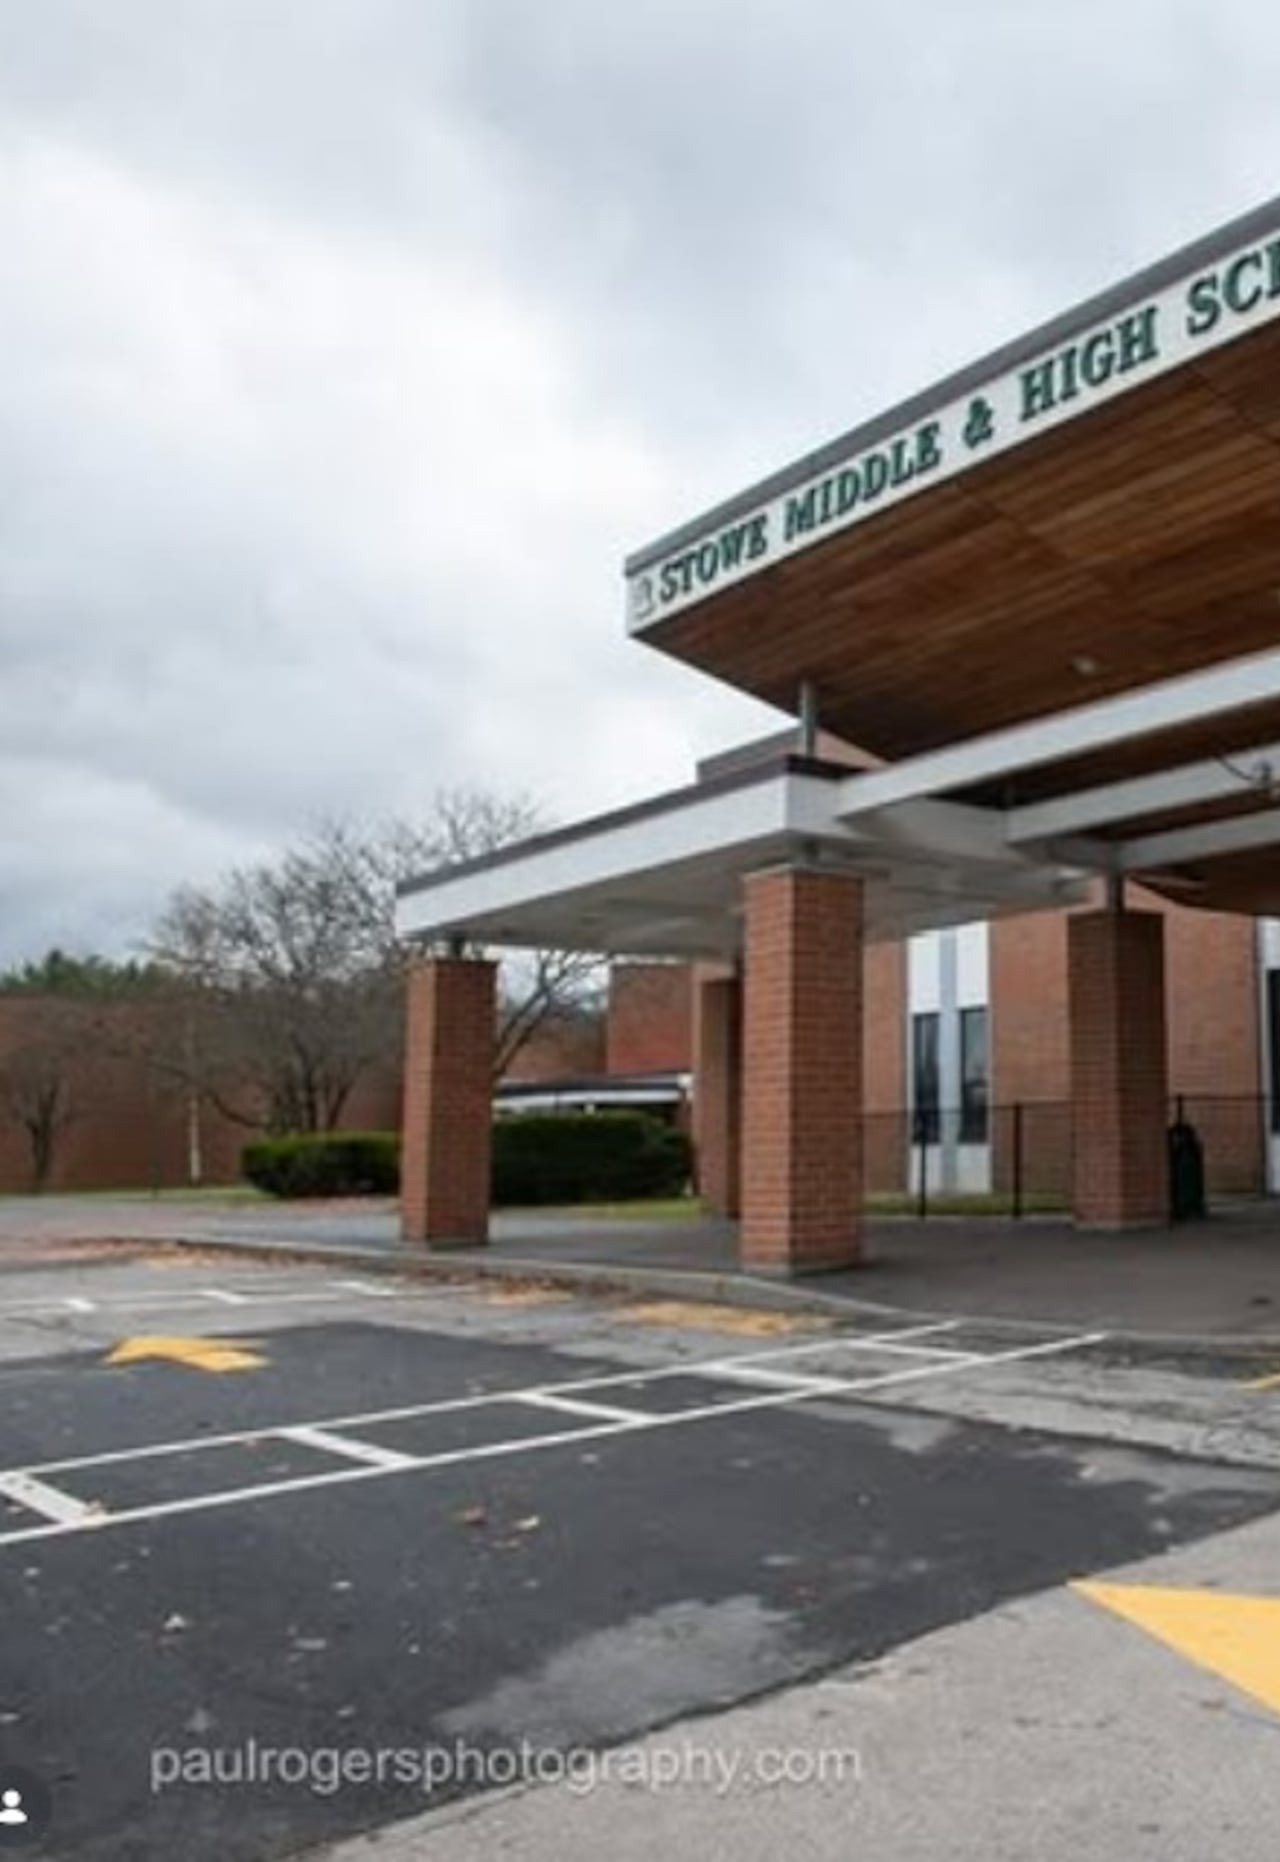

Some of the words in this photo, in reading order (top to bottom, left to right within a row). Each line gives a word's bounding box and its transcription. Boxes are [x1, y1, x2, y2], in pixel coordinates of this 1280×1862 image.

[659, 514, 768, 602] STOWE
[784, 422, 941, 541] MIDDLE
[962, 397, 992, 448] &
[1019, 306, 1159, 422] HIGH
